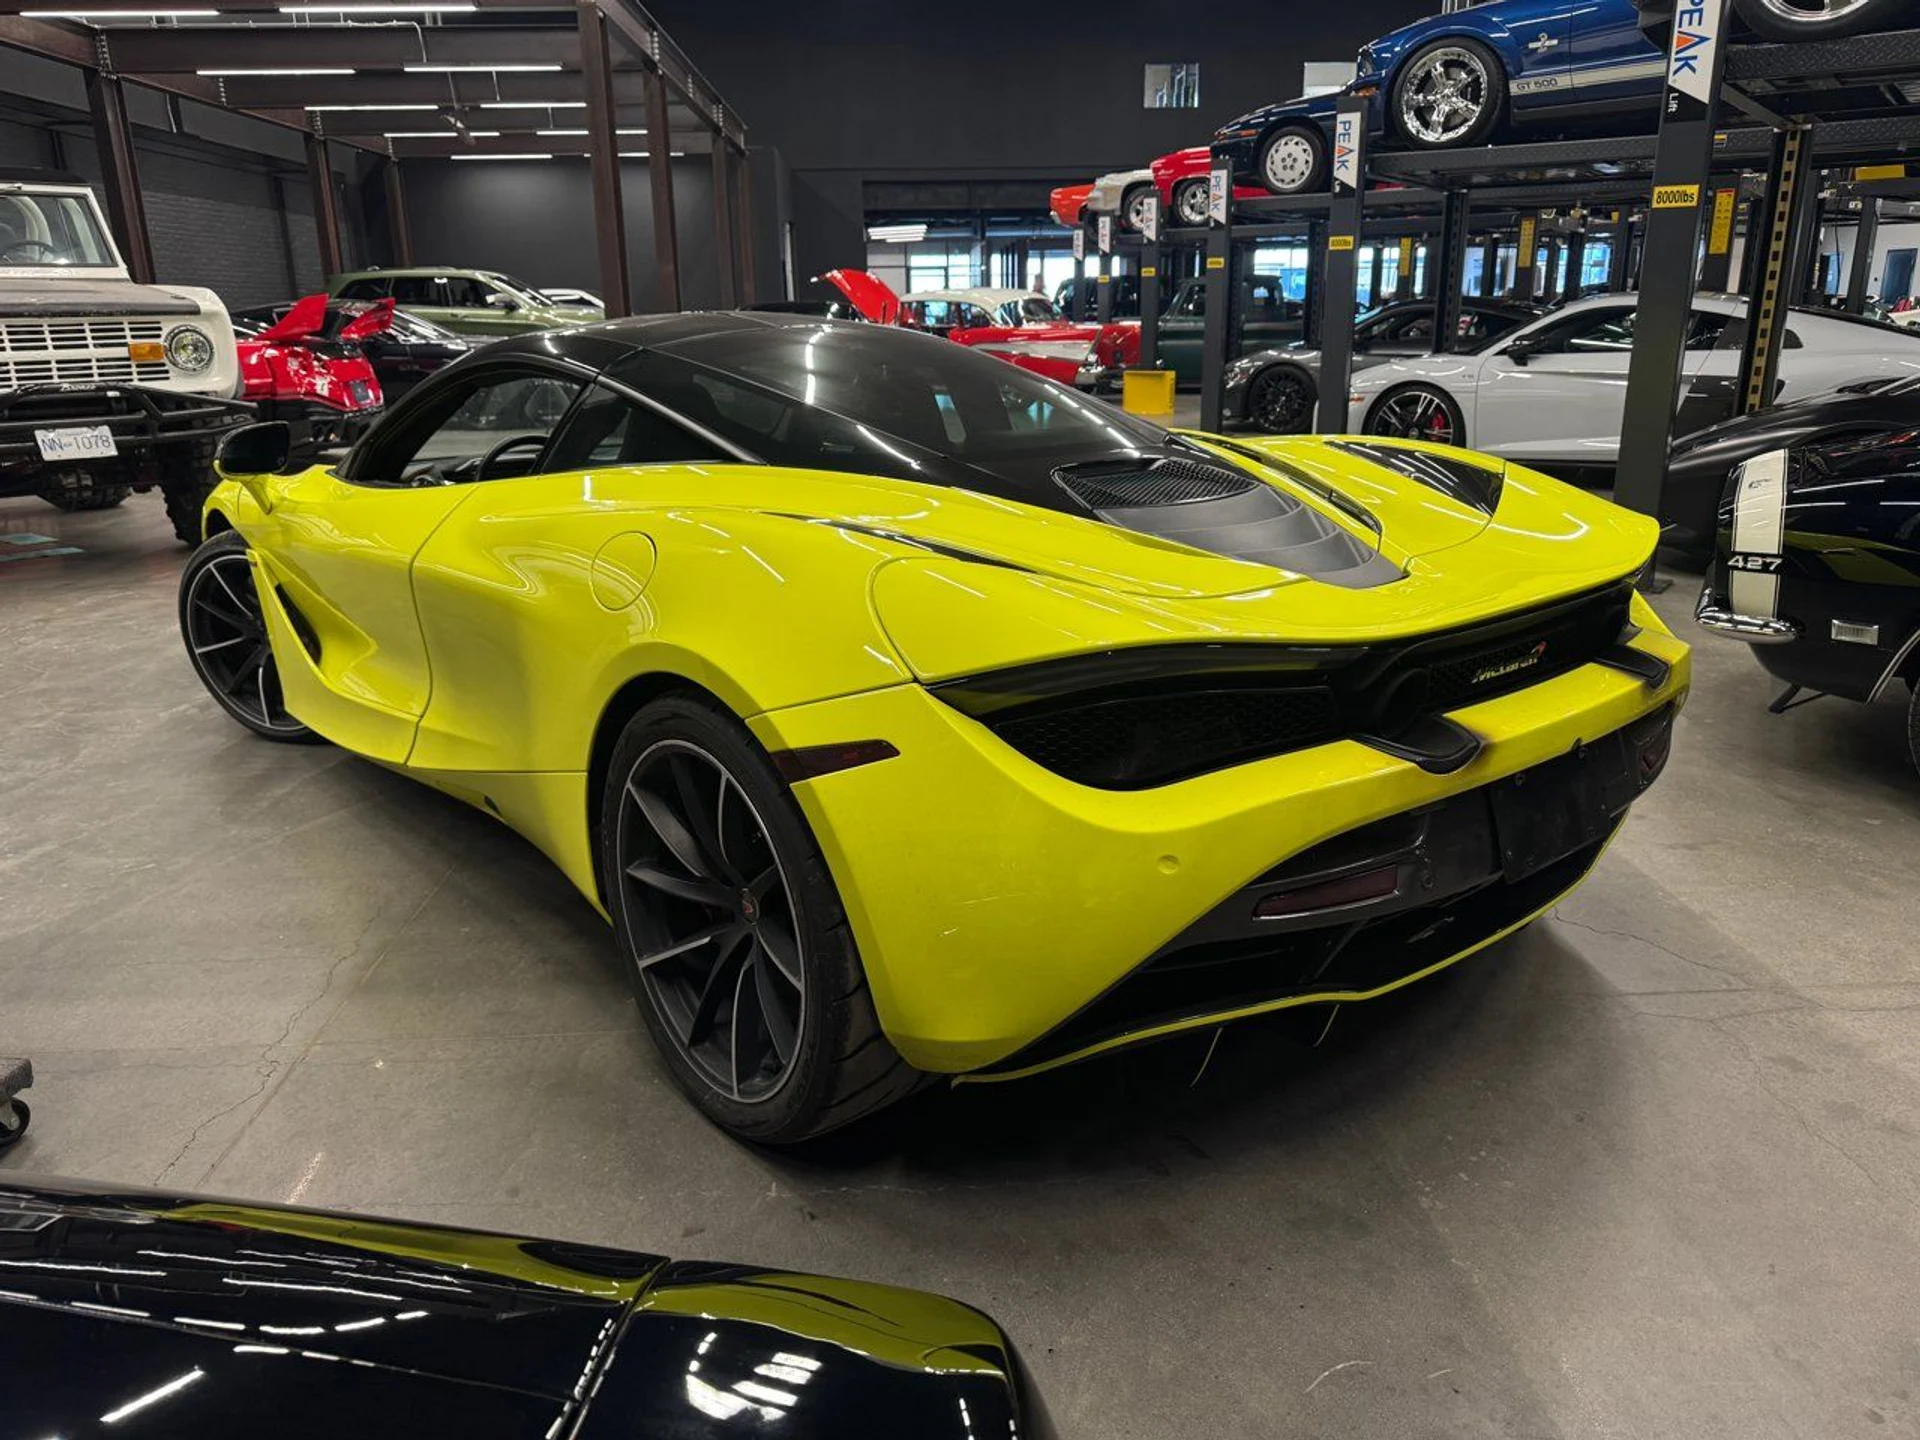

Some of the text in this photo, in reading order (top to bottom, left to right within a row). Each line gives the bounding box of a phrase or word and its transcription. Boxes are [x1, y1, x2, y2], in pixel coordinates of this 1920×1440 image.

[1516, 78, 1559, 91] GT 500
[1667, 92, 1680, 113] Lift
[1336, 119, 1356, 172] PEAK
[1656, 189, 1696, 205] 8000lbs
[1727, 554, 1783, 571] 427
